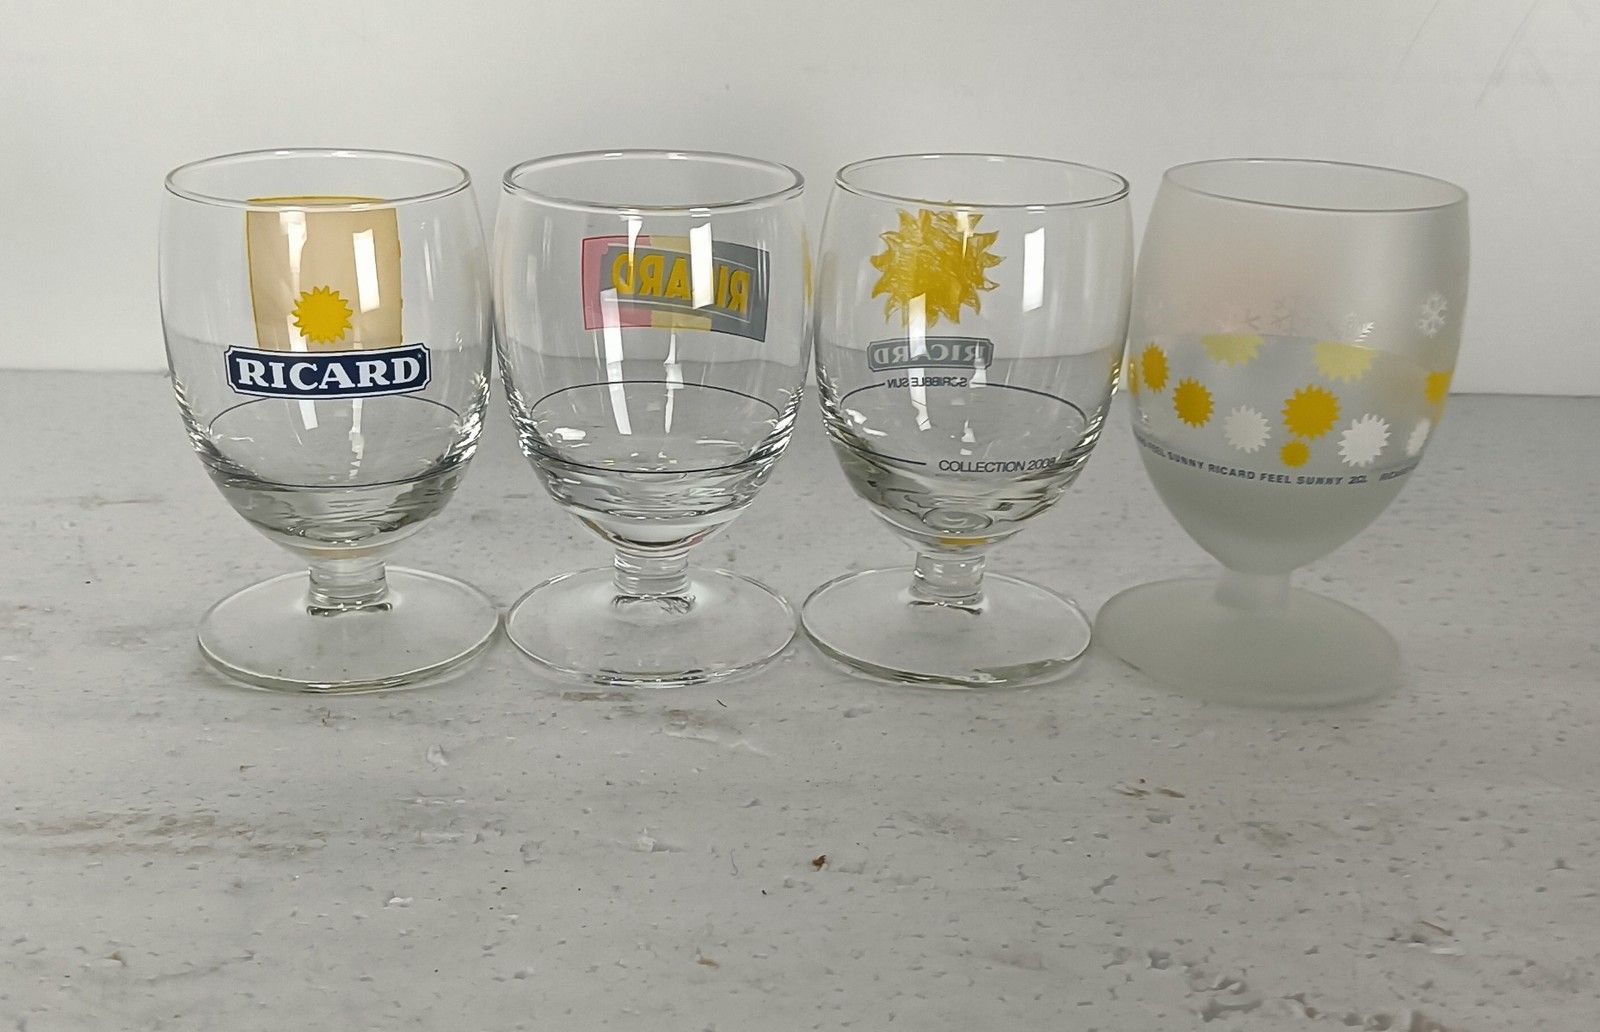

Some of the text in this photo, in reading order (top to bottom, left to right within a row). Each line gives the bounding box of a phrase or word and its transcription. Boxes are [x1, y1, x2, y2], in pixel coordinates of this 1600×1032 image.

[236, 357, 420, 391] RICARD
[939, 460, 1026, 473] COLLECTION
[1208, 463, 1256, 480] RICARD
[1260, 472, 1292, 484] FEEL
[1296, 475, 1344, 486] SUNNY
